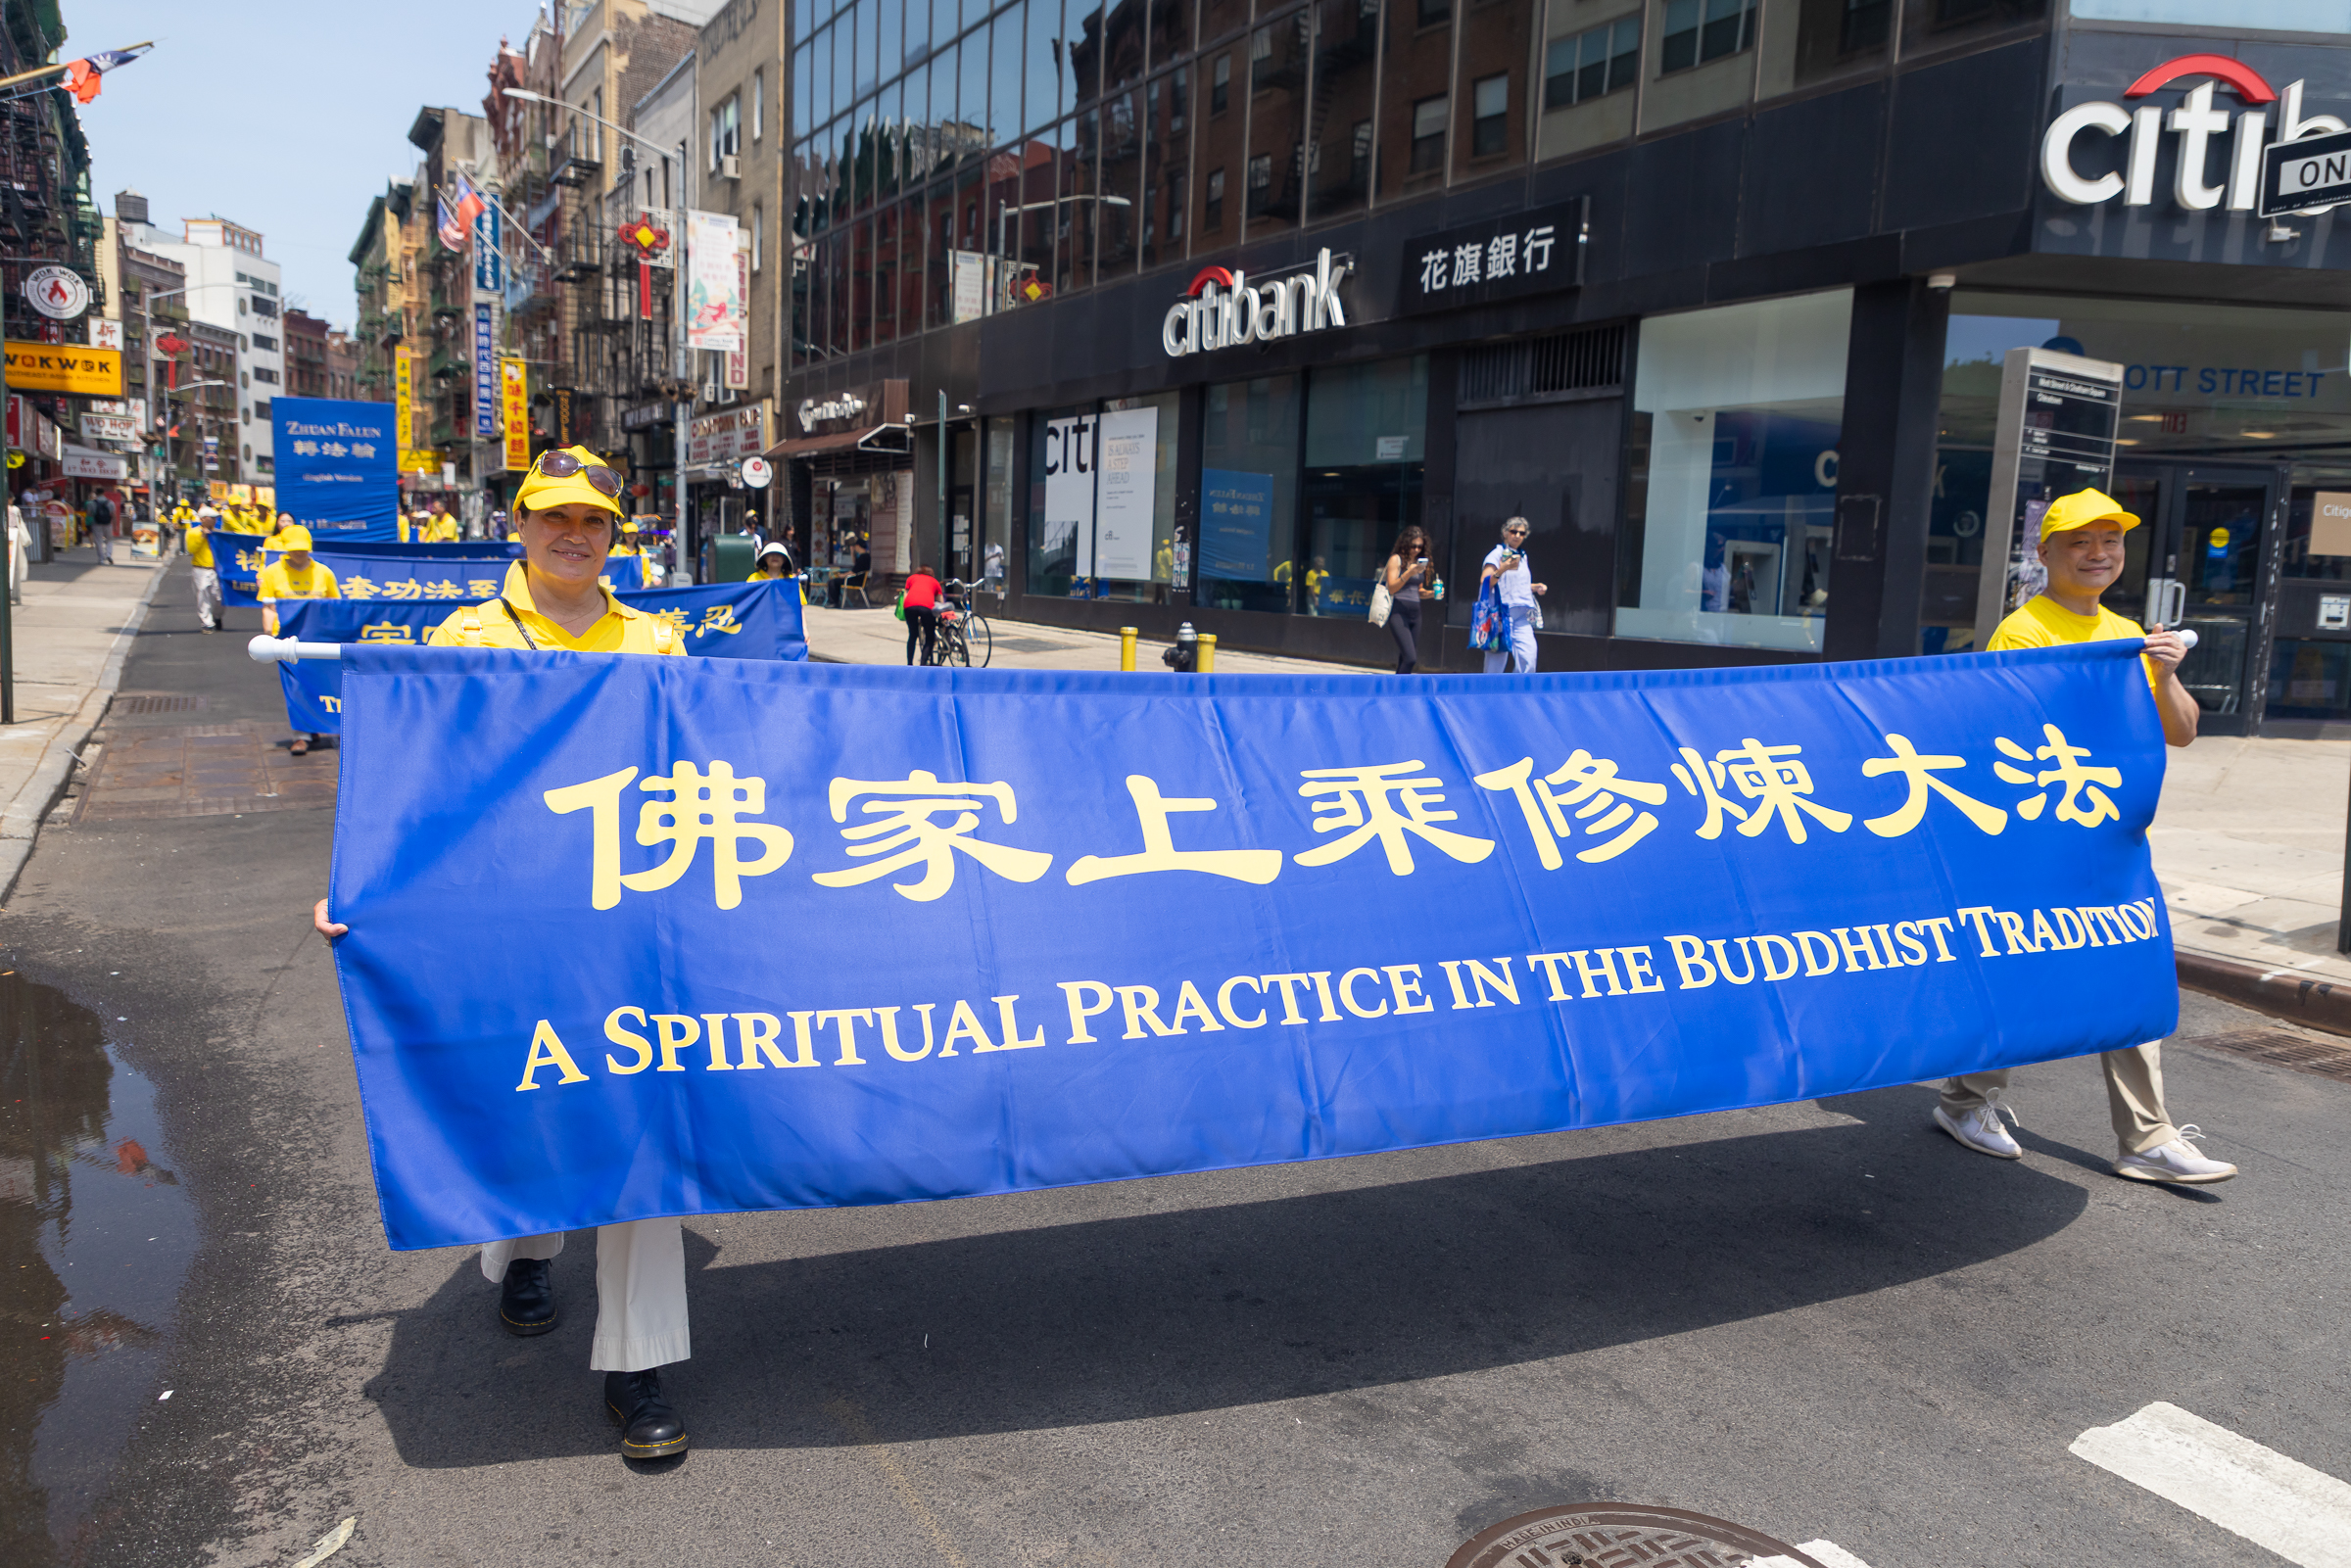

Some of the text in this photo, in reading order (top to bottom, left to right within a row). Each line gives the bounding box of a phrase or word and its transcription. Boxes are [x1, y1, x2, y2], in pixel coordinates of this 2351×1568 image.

[2299, 154, 2351, 187] ON
[1420, 225, 1555, 293] 花旗銀行
[1163, 247, 1346, 357] citibank
[2124, 364, 2326, 398] OTT STREET
[110, 418, 134, 431] HOP
[2323, 503, 2351, 520] Citig
[544, 724, 2122, 910] 佛家上乘修煉大法
[516, 897, 2159, 1091] A SPIRITUAL PRACTICE IN THE BUDDHIST TRADITION
[1501, 1530, 1539, 1548] MADE
[1539, 1523, 1557, 1534] IN
